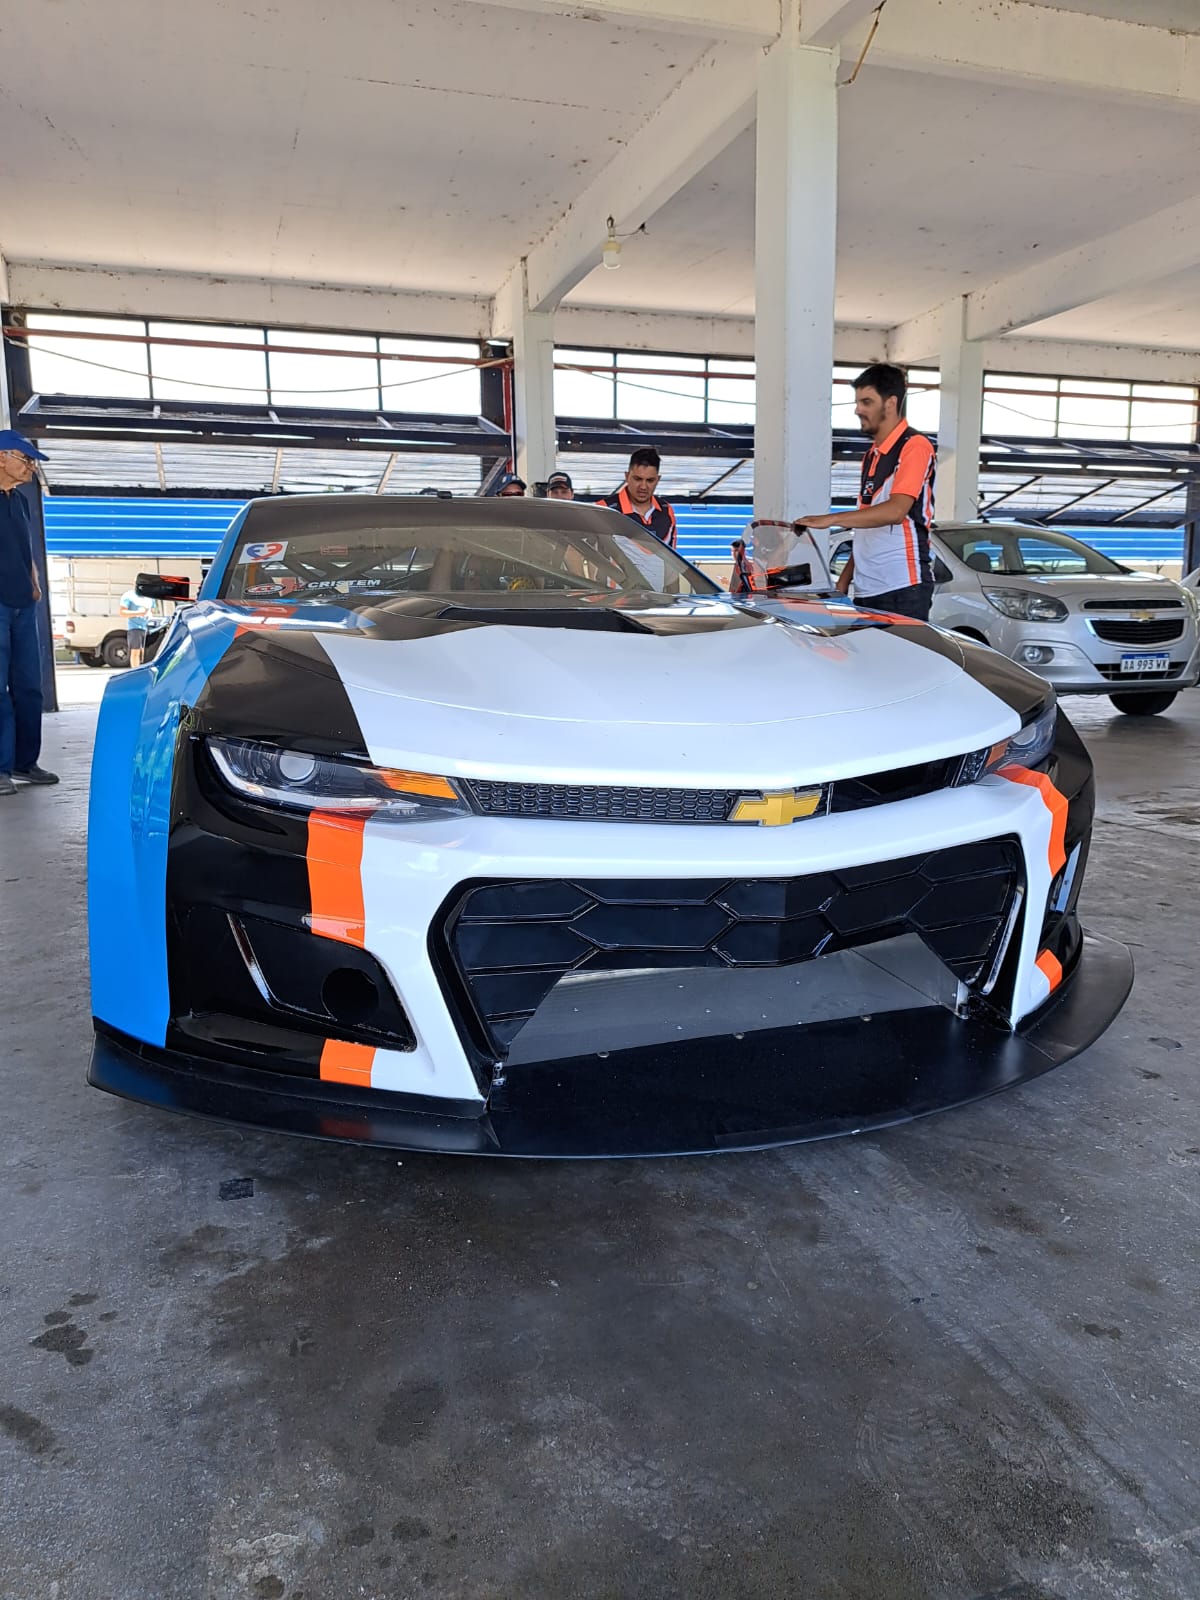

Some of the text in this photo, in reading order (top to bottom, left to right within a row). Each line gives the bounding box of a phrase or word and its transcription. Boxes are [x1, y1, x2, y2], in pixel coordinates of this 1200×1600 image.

[307, 579, 381, 588] CRISTEM
[1124, 660, 1135, 671] AA
[1137, 659, 1153, 670] 993
